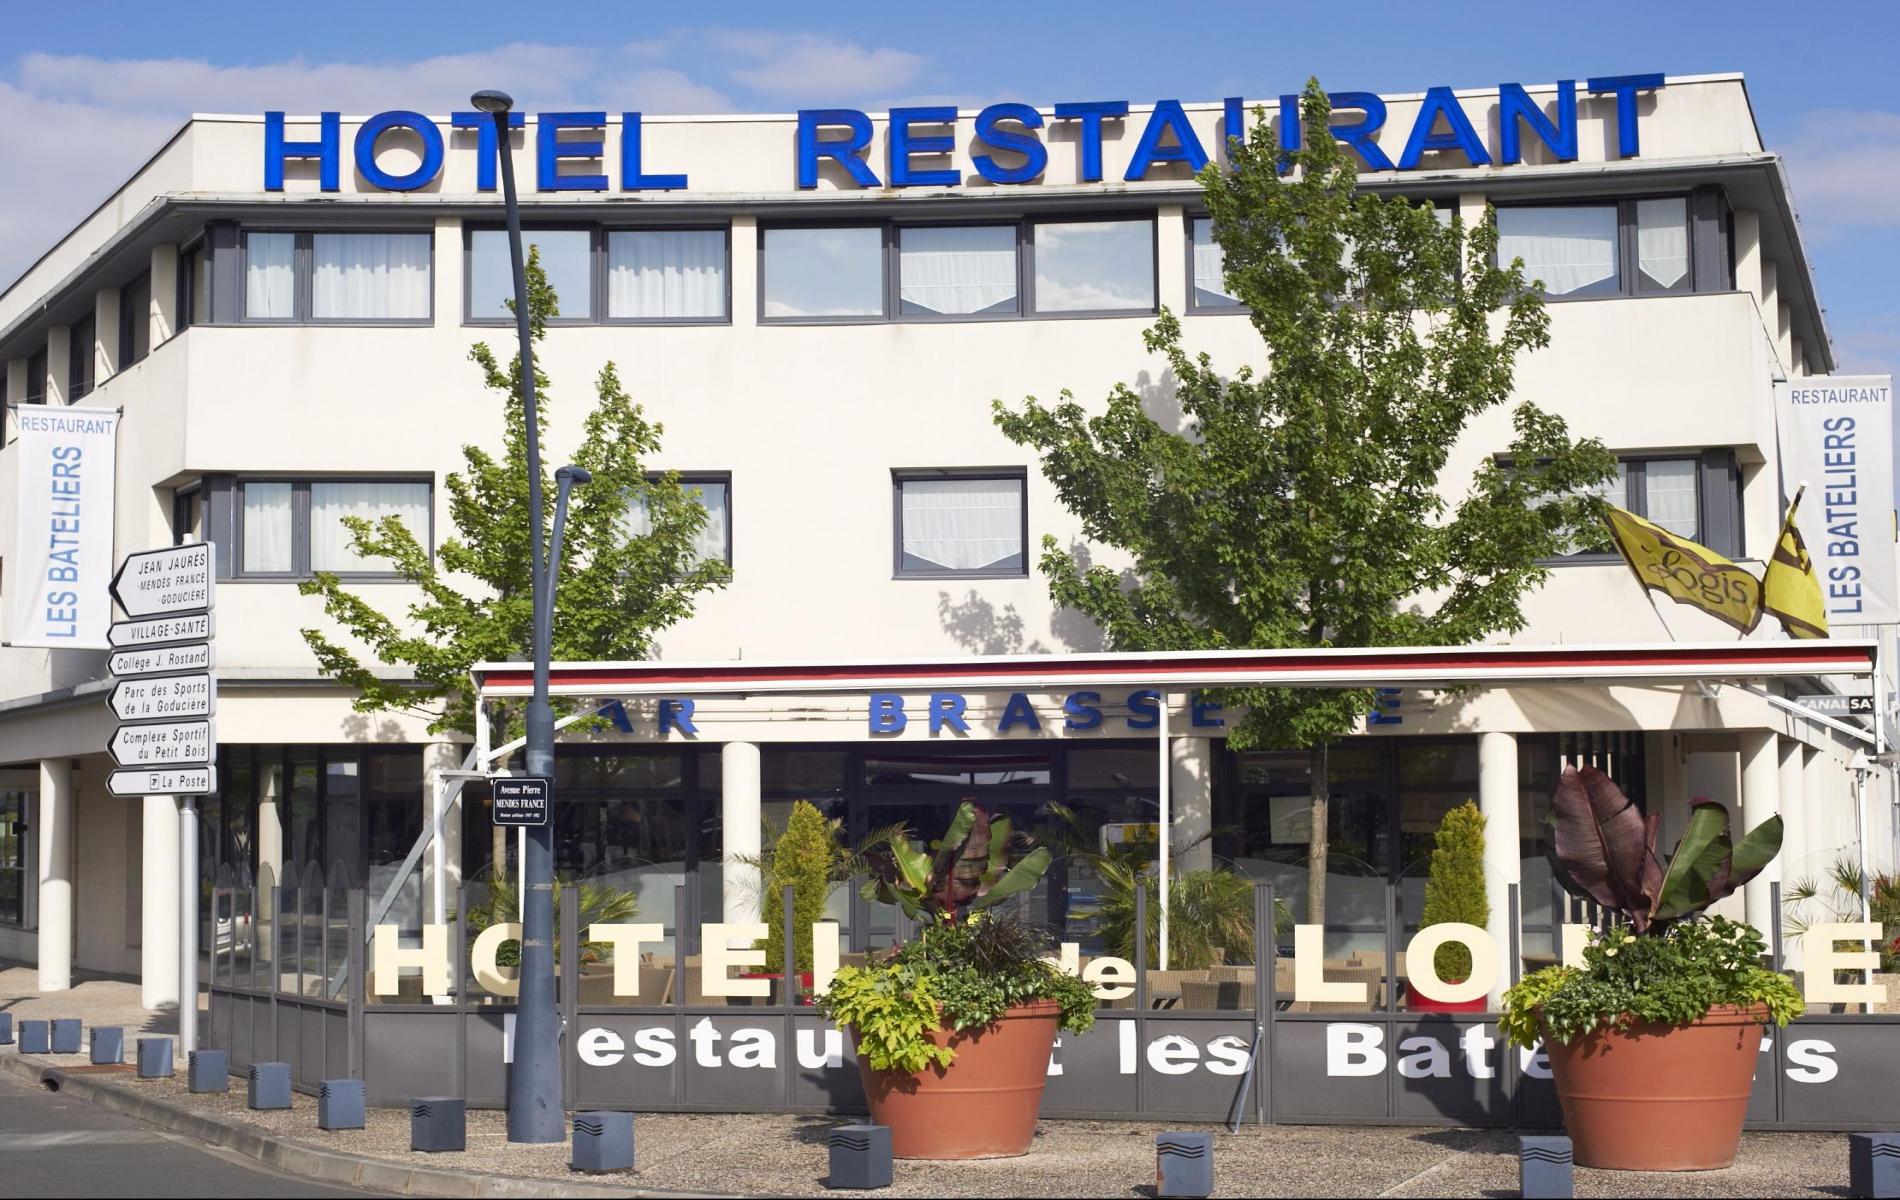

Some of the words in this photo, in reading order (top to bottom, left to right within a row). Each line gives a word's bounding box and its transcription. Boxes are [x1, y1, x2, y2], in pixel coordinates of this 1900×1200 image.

[264, 110, 688, 193] HOTEL
[797, 73, 1665, 189] RESTAURANT
[1791, 387, 1889, 405] RESTAURANT
[21, 416, 113, 435] RESTAURANT
[1824, 416, 1860, 557] BATELIERS
[47, 446, 82, 583] BATELIERS
[138, 559, 161, 575] JEAN
[168, 551, 204, 570] JAURÈS
[175, 572, 205, 586] FRANCE
[1829, 565, 1863, 615] LES
[46, 591, 78, 638] LES
[131, 620, 205, 638] VILLAGE-SANTÉ
[117, 656, 149, 670] Collège
[168, 650, 206, 664] Rostand
[124, 686, 144, 697] Parc
[151, 685, 166, 696] des
[174, 682, 205, 696] Sports
[125, 703, 135, 714] de
[141, 701, 149, 712] la
[157, 698, 206, 712] Goducière
[591, 698, 700, 734] AR
[868, 687, 1403, 734] BRASSEE
[1797, 698, 1874, 710] CANALSA
[123, 731, 166, 745] Complexe
[172, 727, 206, 743] Sportif
[138, 747, 148, 758] du
[155, 746, 177, 758] Petit
[184, 744, 205, 756] Bois
[162, 775, 172, 787] La
[179, 775, 205, 787] Poste
[522, 785, 541, 793] Pierre
[520, 799, 545, 808] FRANCE
[1118, 1019, 1251, 1076] les
